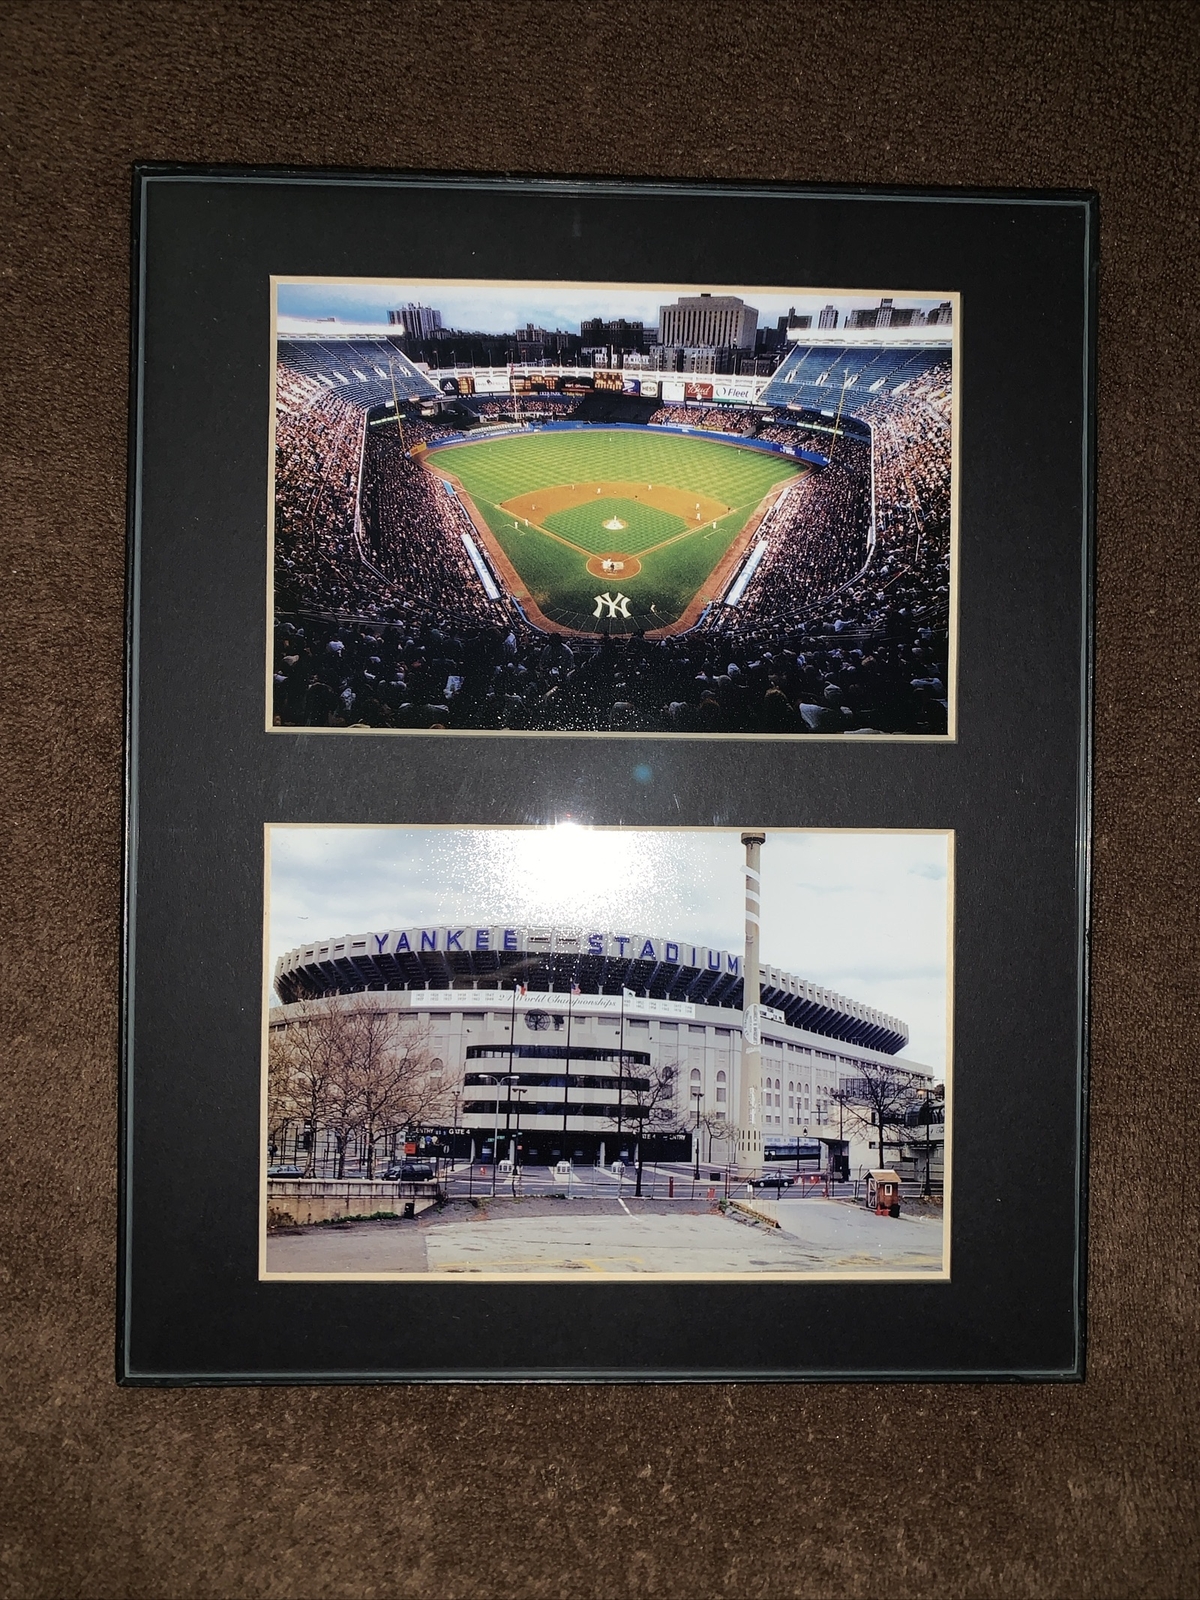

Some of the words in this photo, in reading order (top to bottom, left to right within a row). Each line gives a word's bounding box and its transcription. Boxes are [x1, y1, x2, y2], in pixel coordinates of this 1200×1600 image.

[687, 383, 713, 395] Bud
[727, 387, 749, 398] Fleet
[374, 929, 518, 954] YANKEE
[587, 933, 739, 975] STADIUM
[515, 993, 546, 1004] World
[547, 994, 616, 1008] Championships
[448, 1128, 465, 1136] GATE
